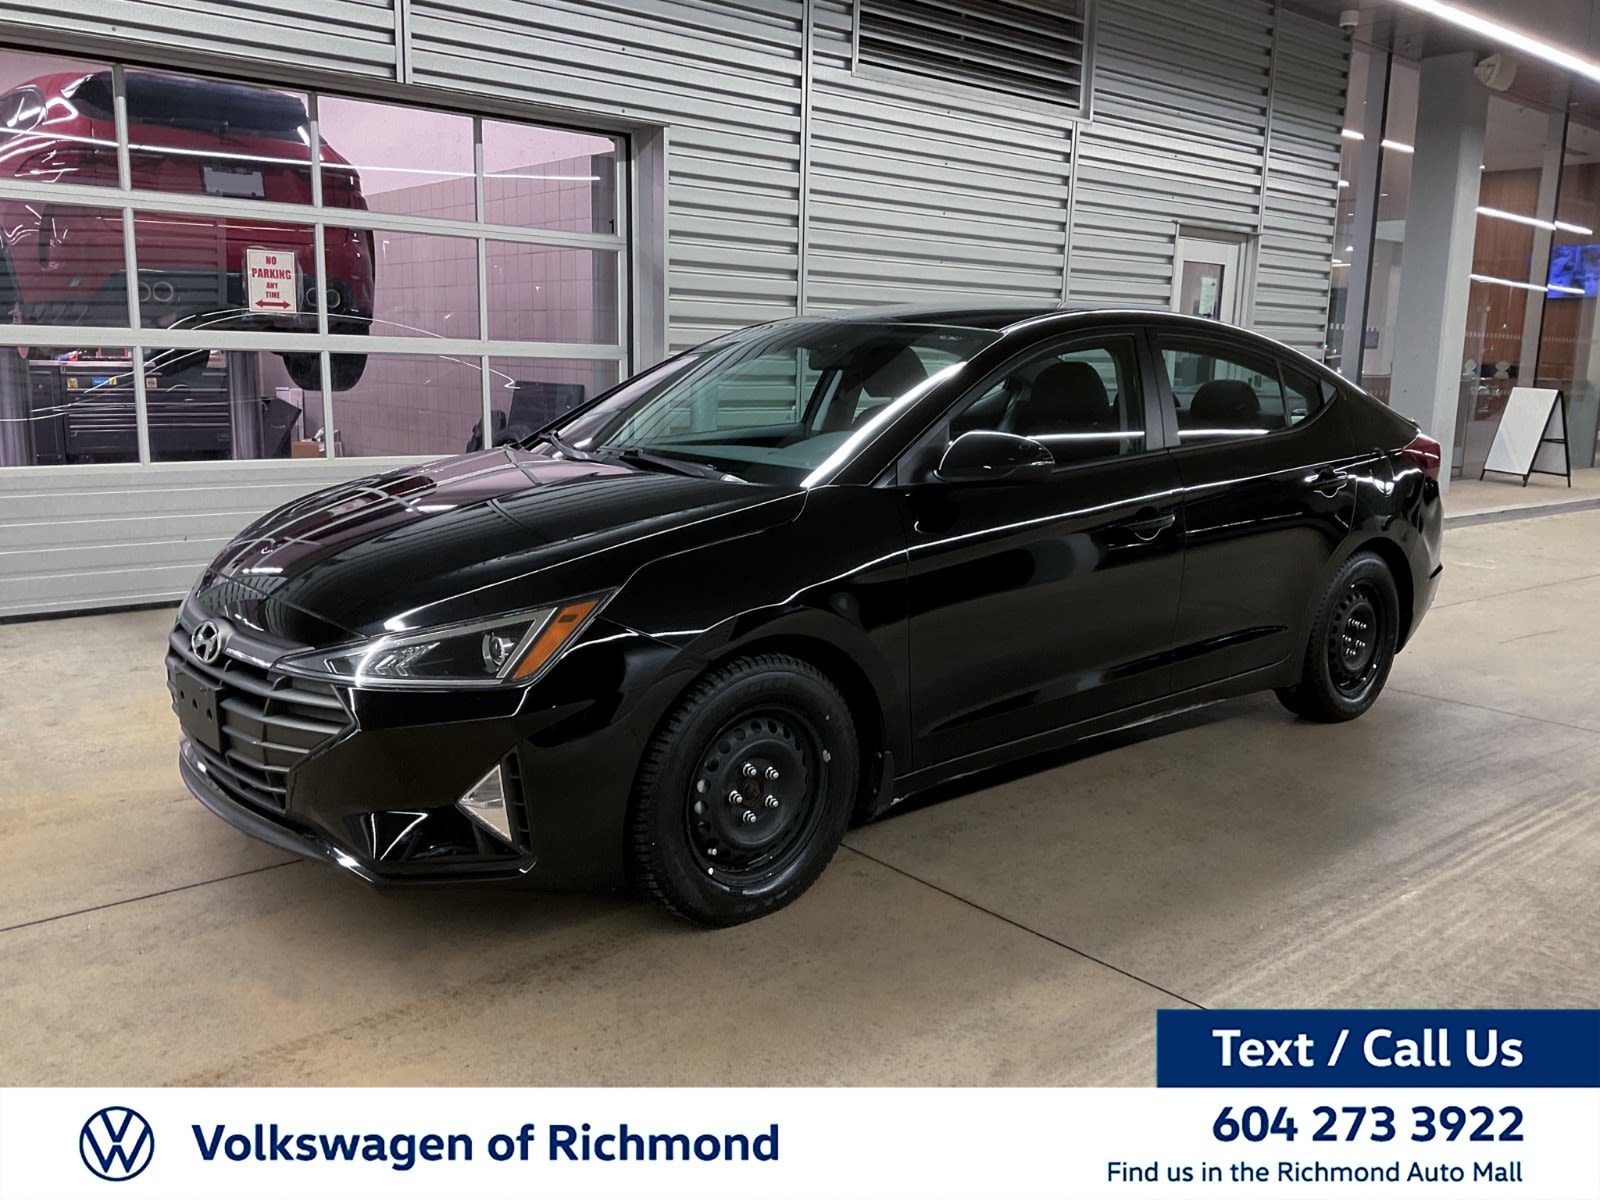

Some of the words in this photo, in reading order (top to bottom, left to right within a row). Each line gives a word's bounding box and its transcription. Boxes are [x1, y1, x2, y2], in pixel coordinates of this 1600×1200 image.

[266, 256, 277, 265] NO
[252, 268, 292, 280] PARKING
[266, 282, 278, 290] ANY
